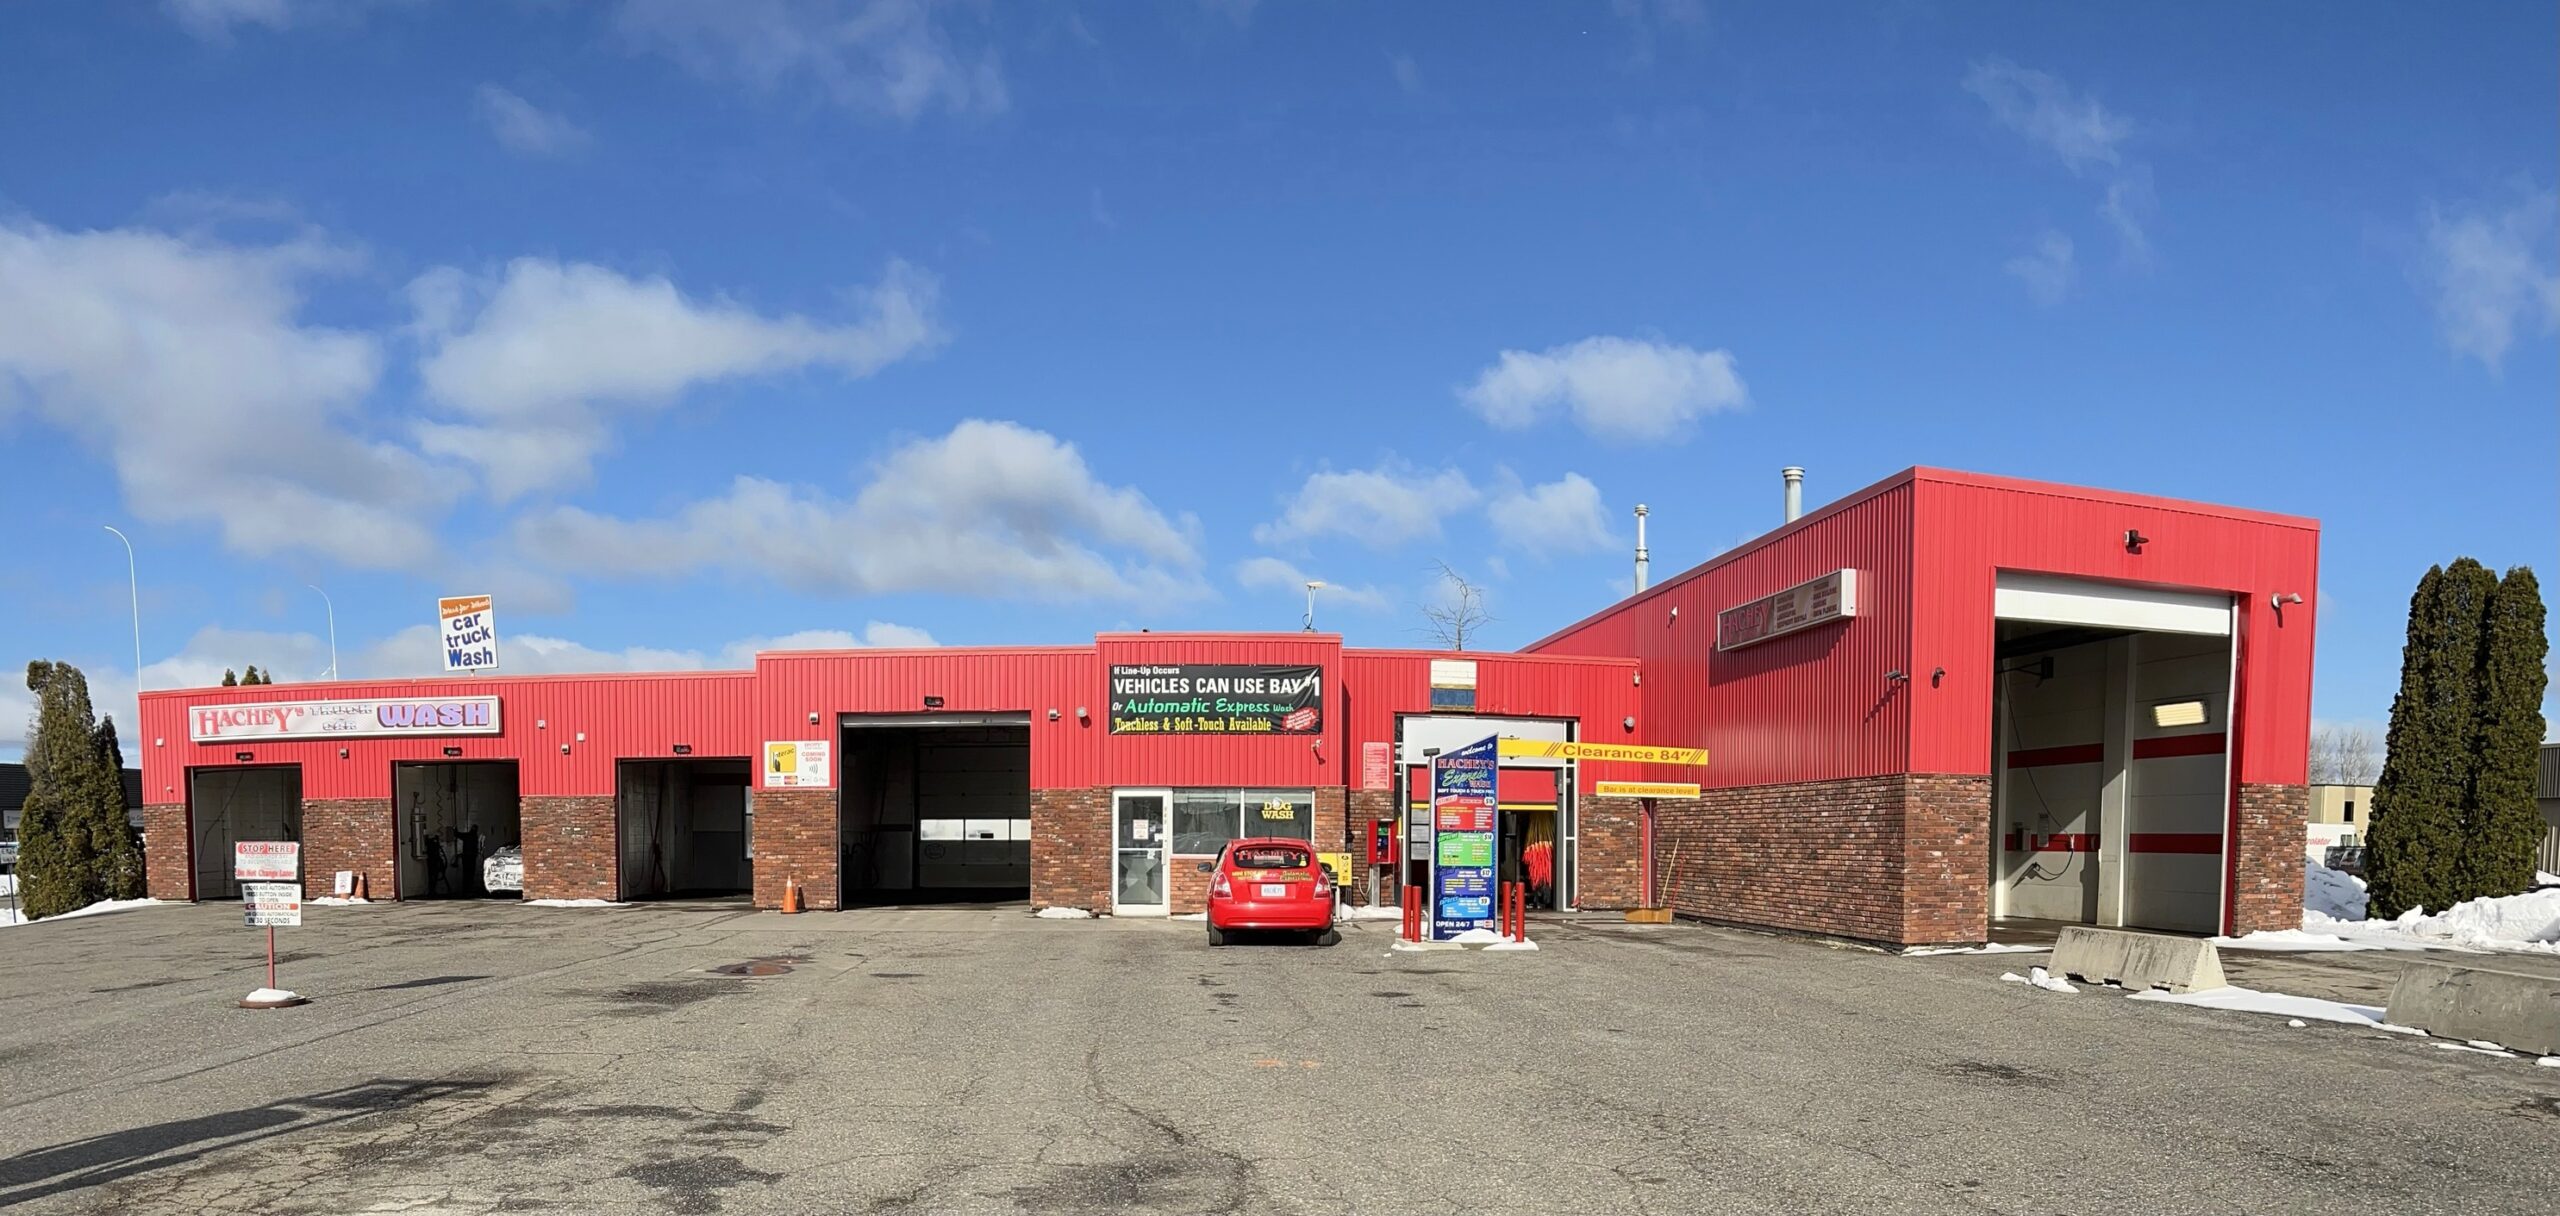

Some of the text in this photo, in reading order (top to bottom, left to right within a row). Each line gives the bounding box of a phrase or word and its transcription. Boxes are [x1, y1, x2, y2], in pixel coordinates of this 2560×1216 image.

[453, 613, 481, 631] car
[446, 626, 491, 648] truck
[448, 647, 493, 667] Wash
[1114, 666, 1180, 676] If Line-Up Occurs
[1114, 678, 1190, 694] VEHICLES
[1196, 678, 1231, 694] CAN
[1234, 678, 1264, 693] USE
[1270, 678, 1301, 694] BAY
[1112, 702, 1123, 711] Or
[1125, 698, 1210, 713] Automatic
[1216, 698, 1270, 716] Express
[377, 703, 490, 728] WASH
[1114, 717, 1159, 731] Touchless
[1163, 718, 1170, 731] &
[1229, 717, 1271, 731] Available
[1563, 745, 1654, 760] Clearance
[1442, 768, 1488, 786] Express
[1603, 785, 1617, 793] Bar
[1619, 785, 1625, 793] is
[1637, 786, 1679, 795] clearance
[1681, 786, 1694, 795] level
[1264, 799, 1292, 810] DOG
[1262, 810, 1294, 820] WASH
[243, 844, 290, 852] STOP HERE
